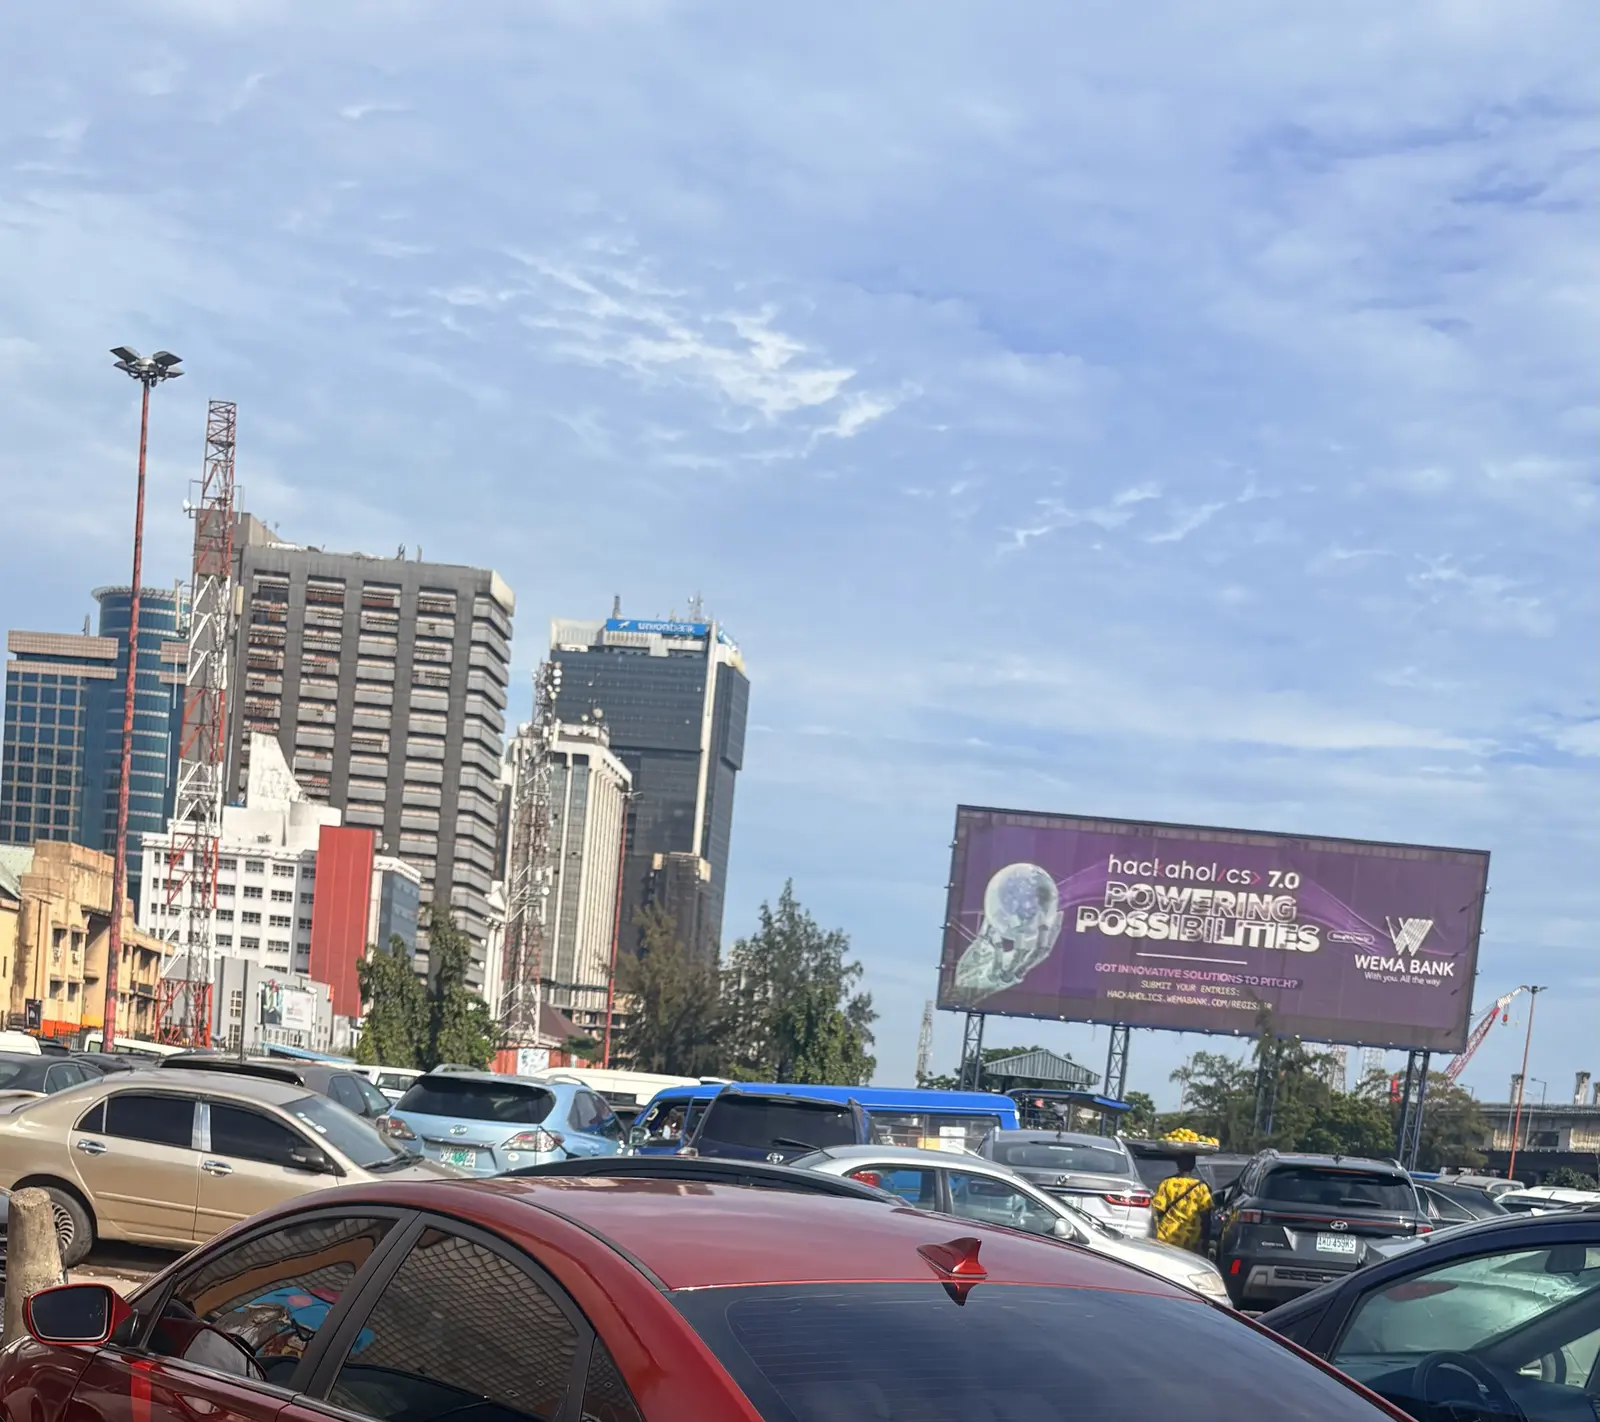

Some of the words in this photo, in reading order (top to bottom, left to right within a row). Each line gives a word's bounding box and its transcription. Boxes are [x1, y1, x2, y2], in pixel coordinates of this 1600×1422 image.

[1267, 870, 1300, 890] 7.0
[1104, 880, 1298, 924] POWERING
[1075, 906, 1321, 953] POSSIBILITIES
[1094, 962, 1118, 973] GOT
[1118, 963, 1182, 979] INNOVATIVE
[1182, 970, 1243, 984] SOLUTIONS
[1243, 976, 1260, 985] TO
[1260, 978, 1300, 989] PITCH?
[1354, 954, 1406, 973] WEMA
[1409, 959, 1455, 977] BANK
[1140, 979, 1172, 990] SUBMIT
[1175, 983, 1197, 993] YOUR
[1200, 985, 1240, 997] ENTRIES:
